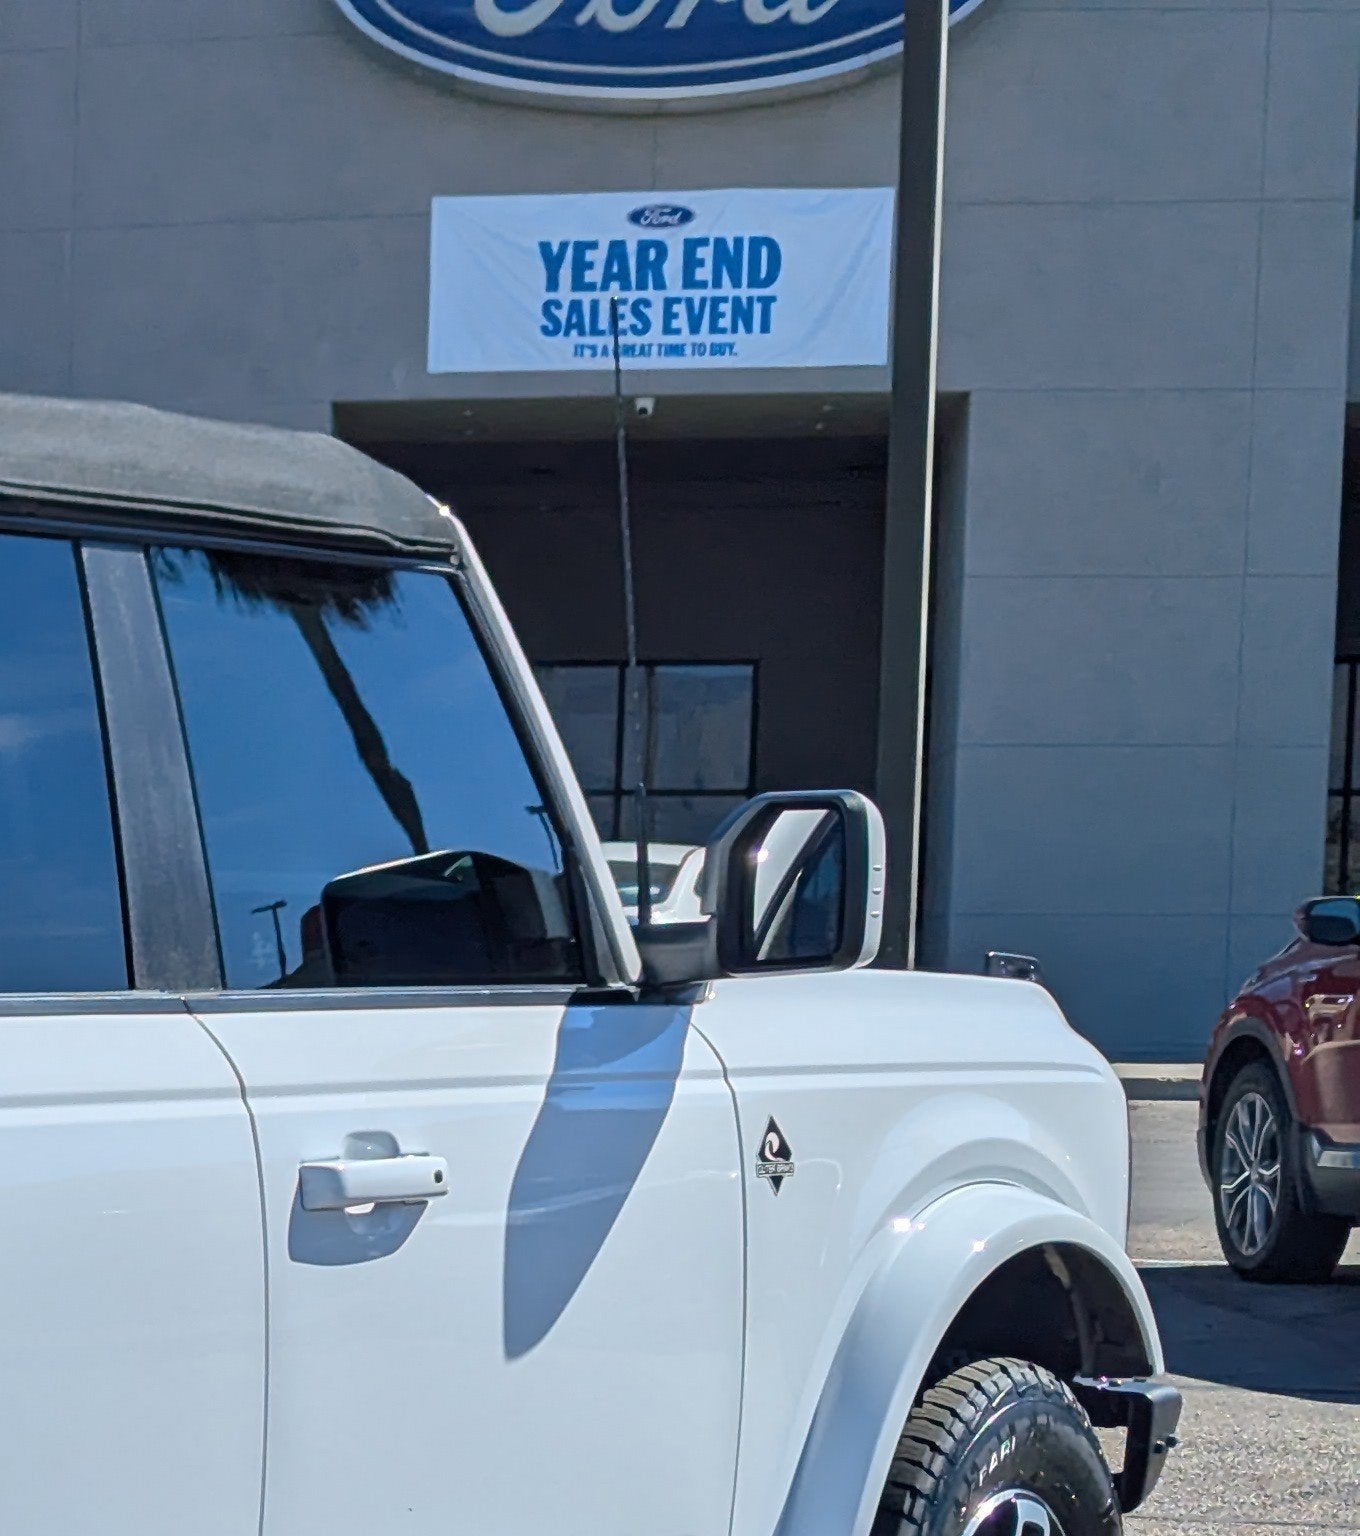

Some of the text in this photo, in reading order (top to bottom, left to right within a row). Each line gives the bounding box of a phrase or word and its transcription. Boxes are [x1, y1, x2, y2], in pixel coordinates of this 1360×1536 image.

[538, 236, 782, 293] YEAR END
[540, 295, 777, 338] SALES EVENT
[617, 343, 653, 358] REAT
[691, 342, 707, 357] TO
